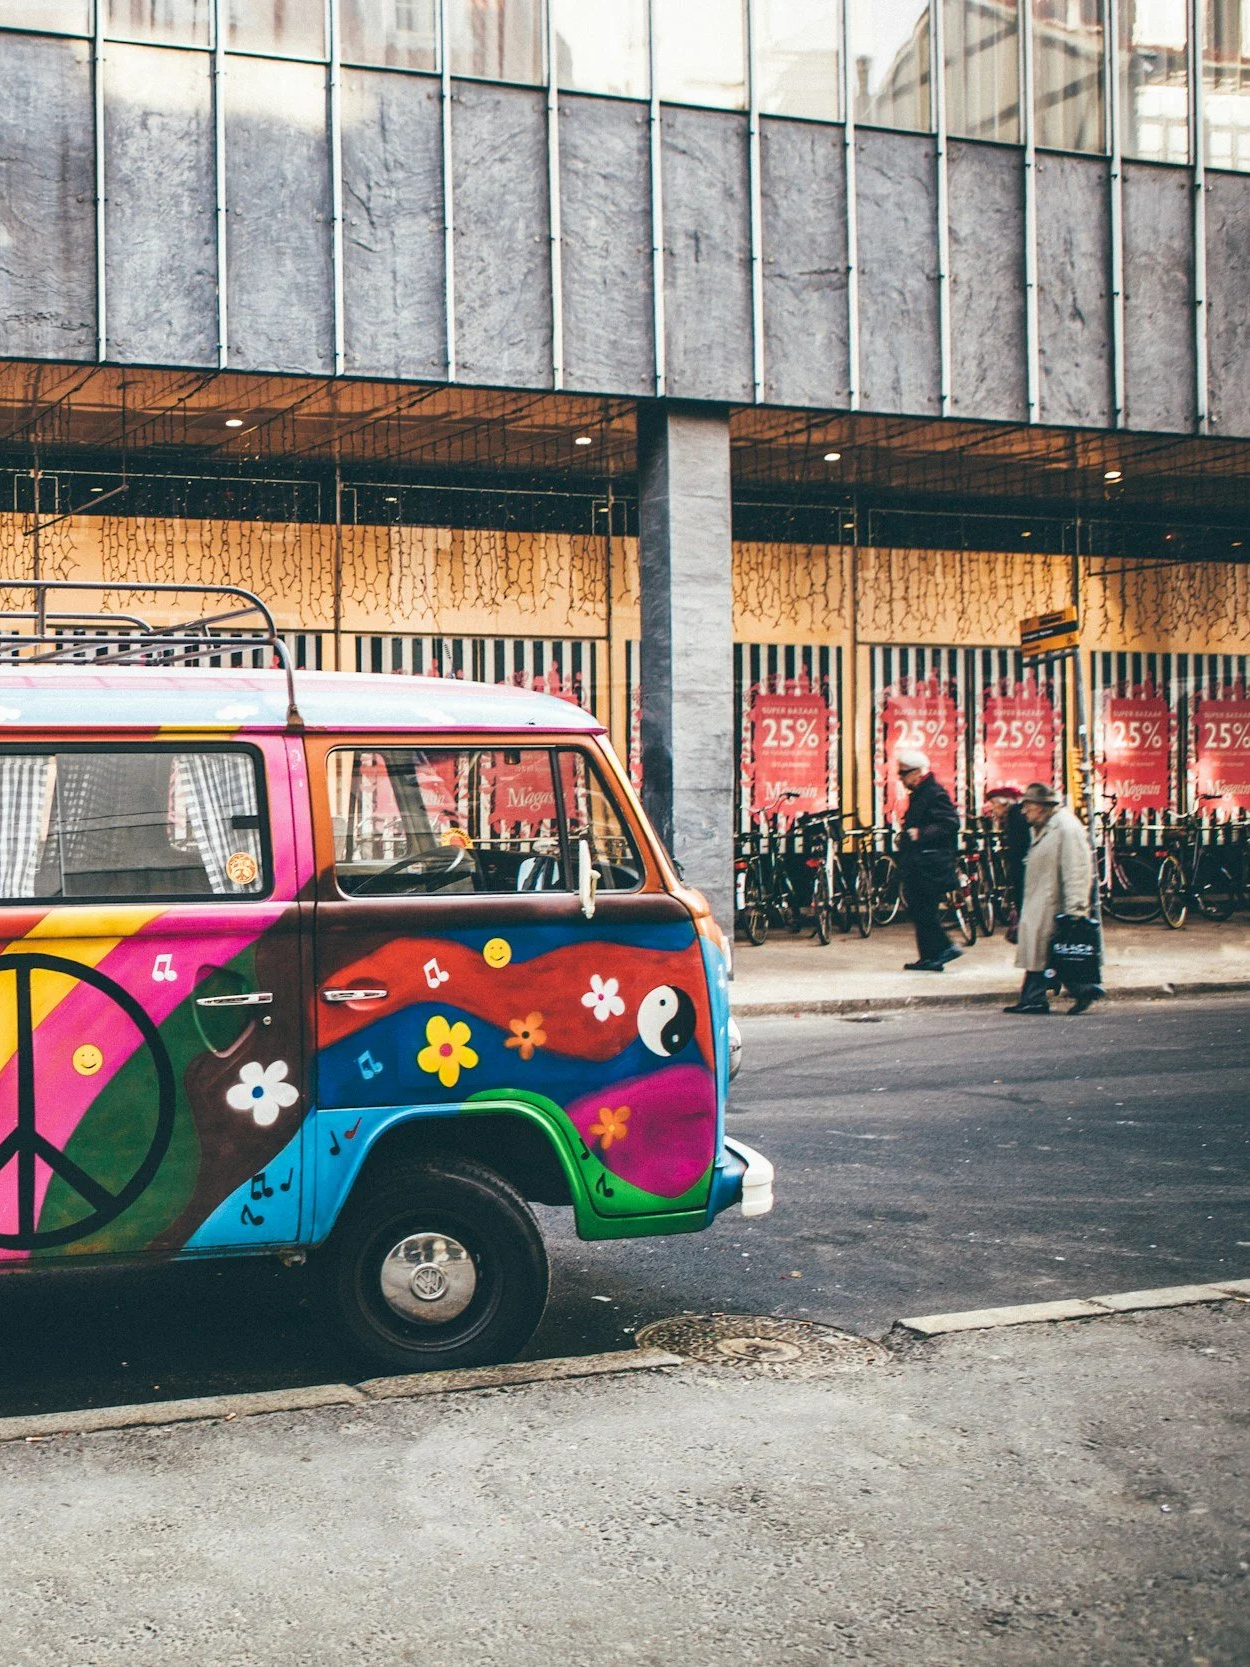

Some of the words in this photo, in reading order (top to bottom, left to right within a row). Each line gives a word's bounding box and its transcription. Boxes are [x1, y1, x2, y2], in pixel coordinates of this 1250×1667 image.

[762, 718, 820, 748] 25%
[893, 719, 949, 749] 25%
[992, 720, 1046, 749] 25%
[1113, 720, 1163, 749] 25%
[1204, 721, 1250, 749] 25%
[506, 786, 565, 812] Magas
[1114, 778, 1162, 802] Magasin
[415, 1268, 444, 1297] VW
